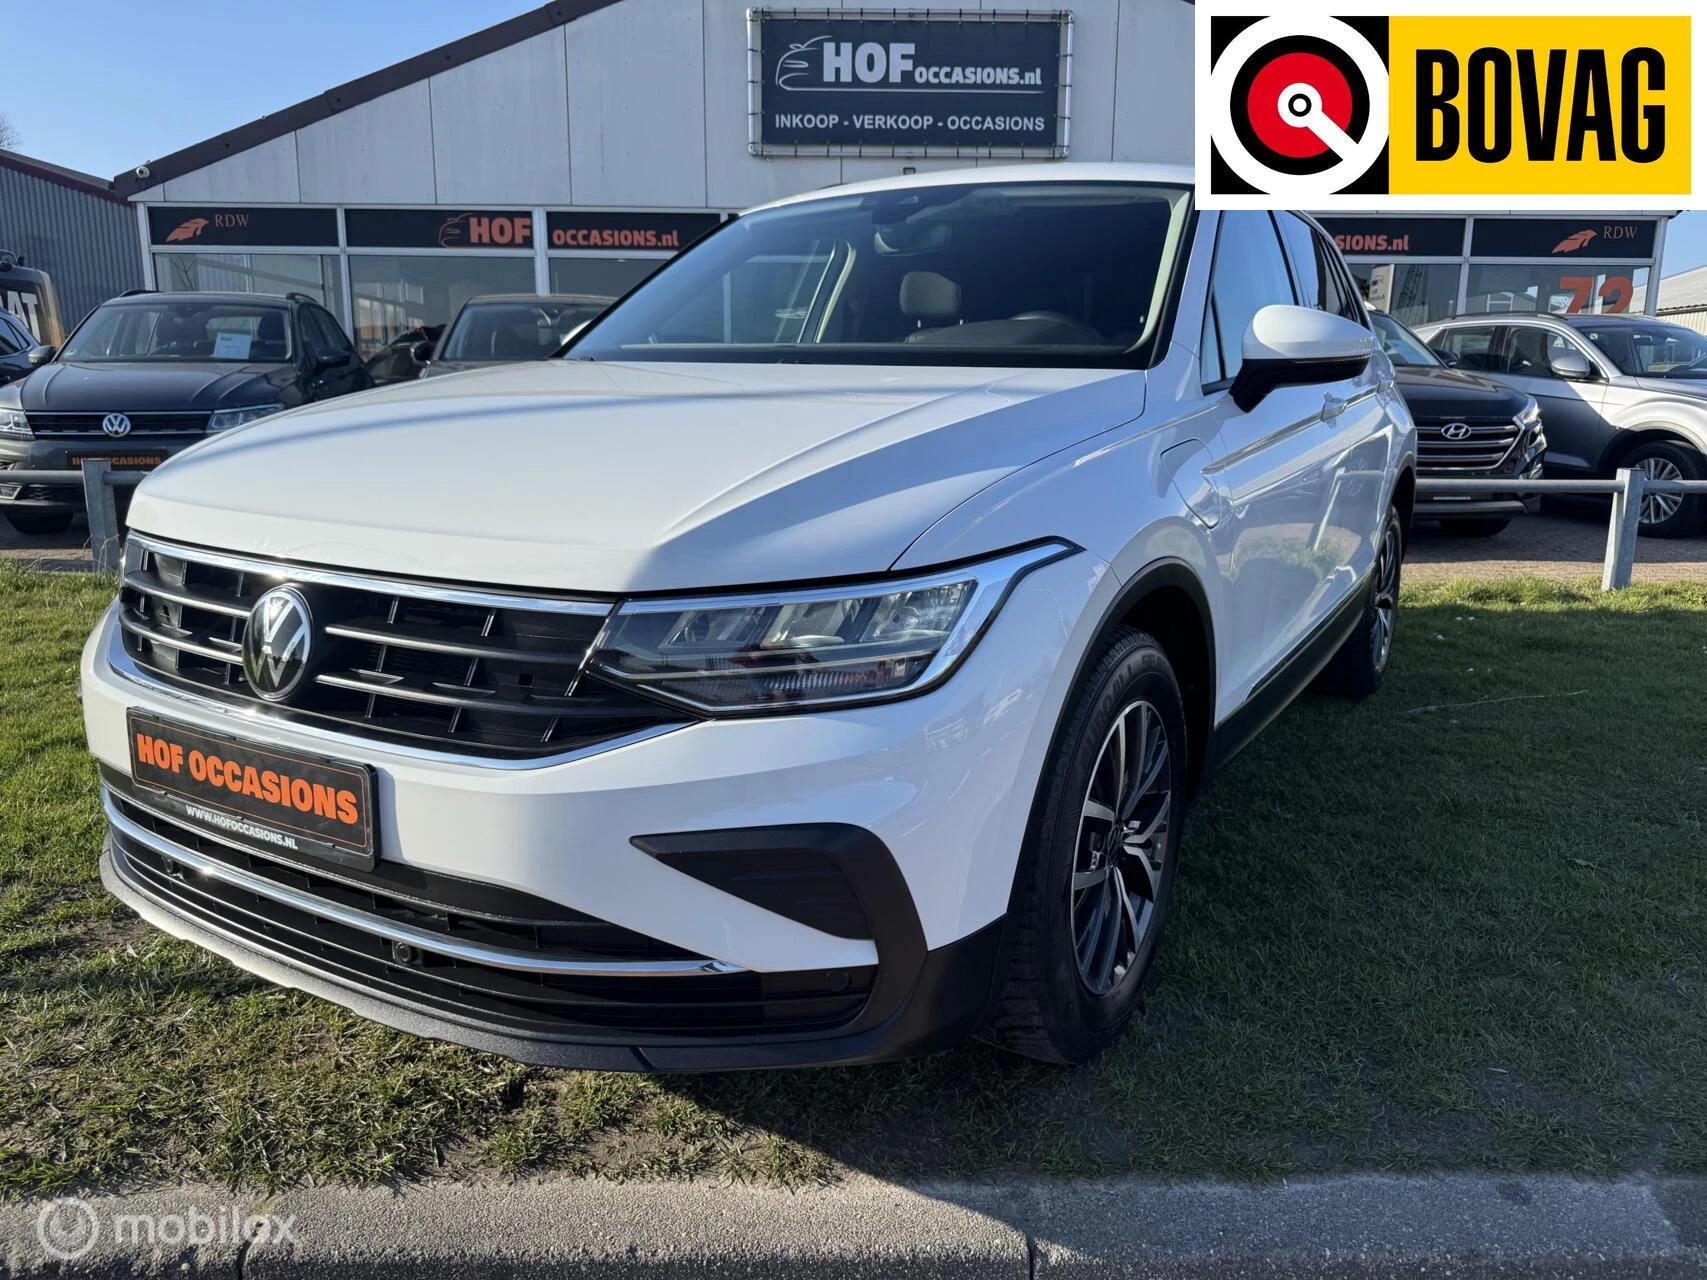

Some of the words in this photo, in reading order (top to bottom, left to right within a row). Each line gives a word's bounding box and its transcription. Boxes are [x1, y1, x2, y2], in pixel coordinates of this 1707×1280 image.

[775, 114, 839, 128] INKOOP
[853, 115, 934, 129] VERKOOP
[947, 115, 1045, 131] OCCASIONS
[214, 213, 249, 228] RDW
[469, 217, 532, 244] HOF
[552, 229, 679, 246] OCCASIONS.nl
[1335, 234, 1409, 251] SIONS.nl
[1603, 226, 1637, 239] RDW
[1559, 275, 1633, 313] 72
[0, 290, 41, 343] AT
[111, 456, 161, 465] CASIONS
[137, 733, 184, 774] HOF
[188, 750, 359, 825] OCCASIONS
[186, 804, 299, 850] WWW.HOFOCCASIONS.NL
